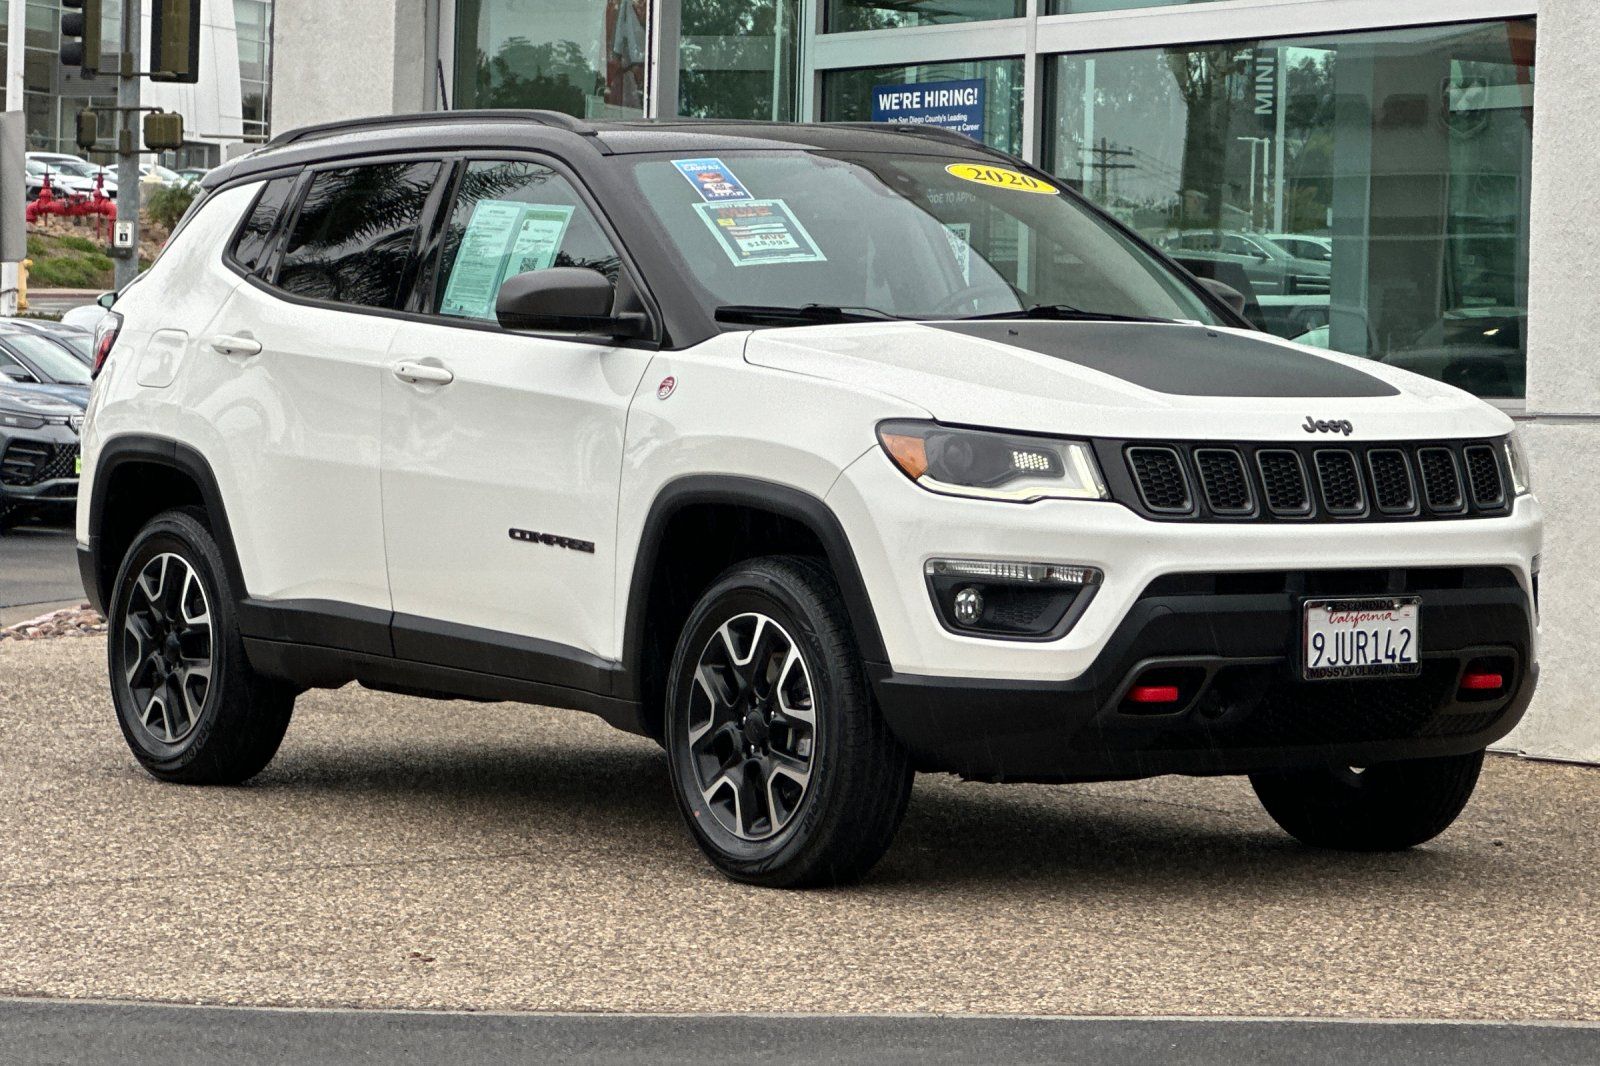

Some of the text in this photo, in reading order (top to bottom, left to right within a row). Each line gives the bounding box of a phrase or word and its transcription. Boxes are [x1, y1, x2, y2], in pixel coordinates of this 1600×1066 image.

[1254, 57, 1274, 114] MINI
[879, 88, 978, 110] WE'RE HIRING!
[910, 115, 924, 124] Diego
[925, 114, 946, 123] County's
[947, 113, 968, 122] Leading
[962, 123, 980, 131] Career
[967, 167, 1039, 189] 2020
[1302, 416, 1353, 436] Jeep
[508, 528, 595, 554] COMPASS
[1328, 611, 1399, 628] California
[1312, 628, 1411, 667] 9JUR142
